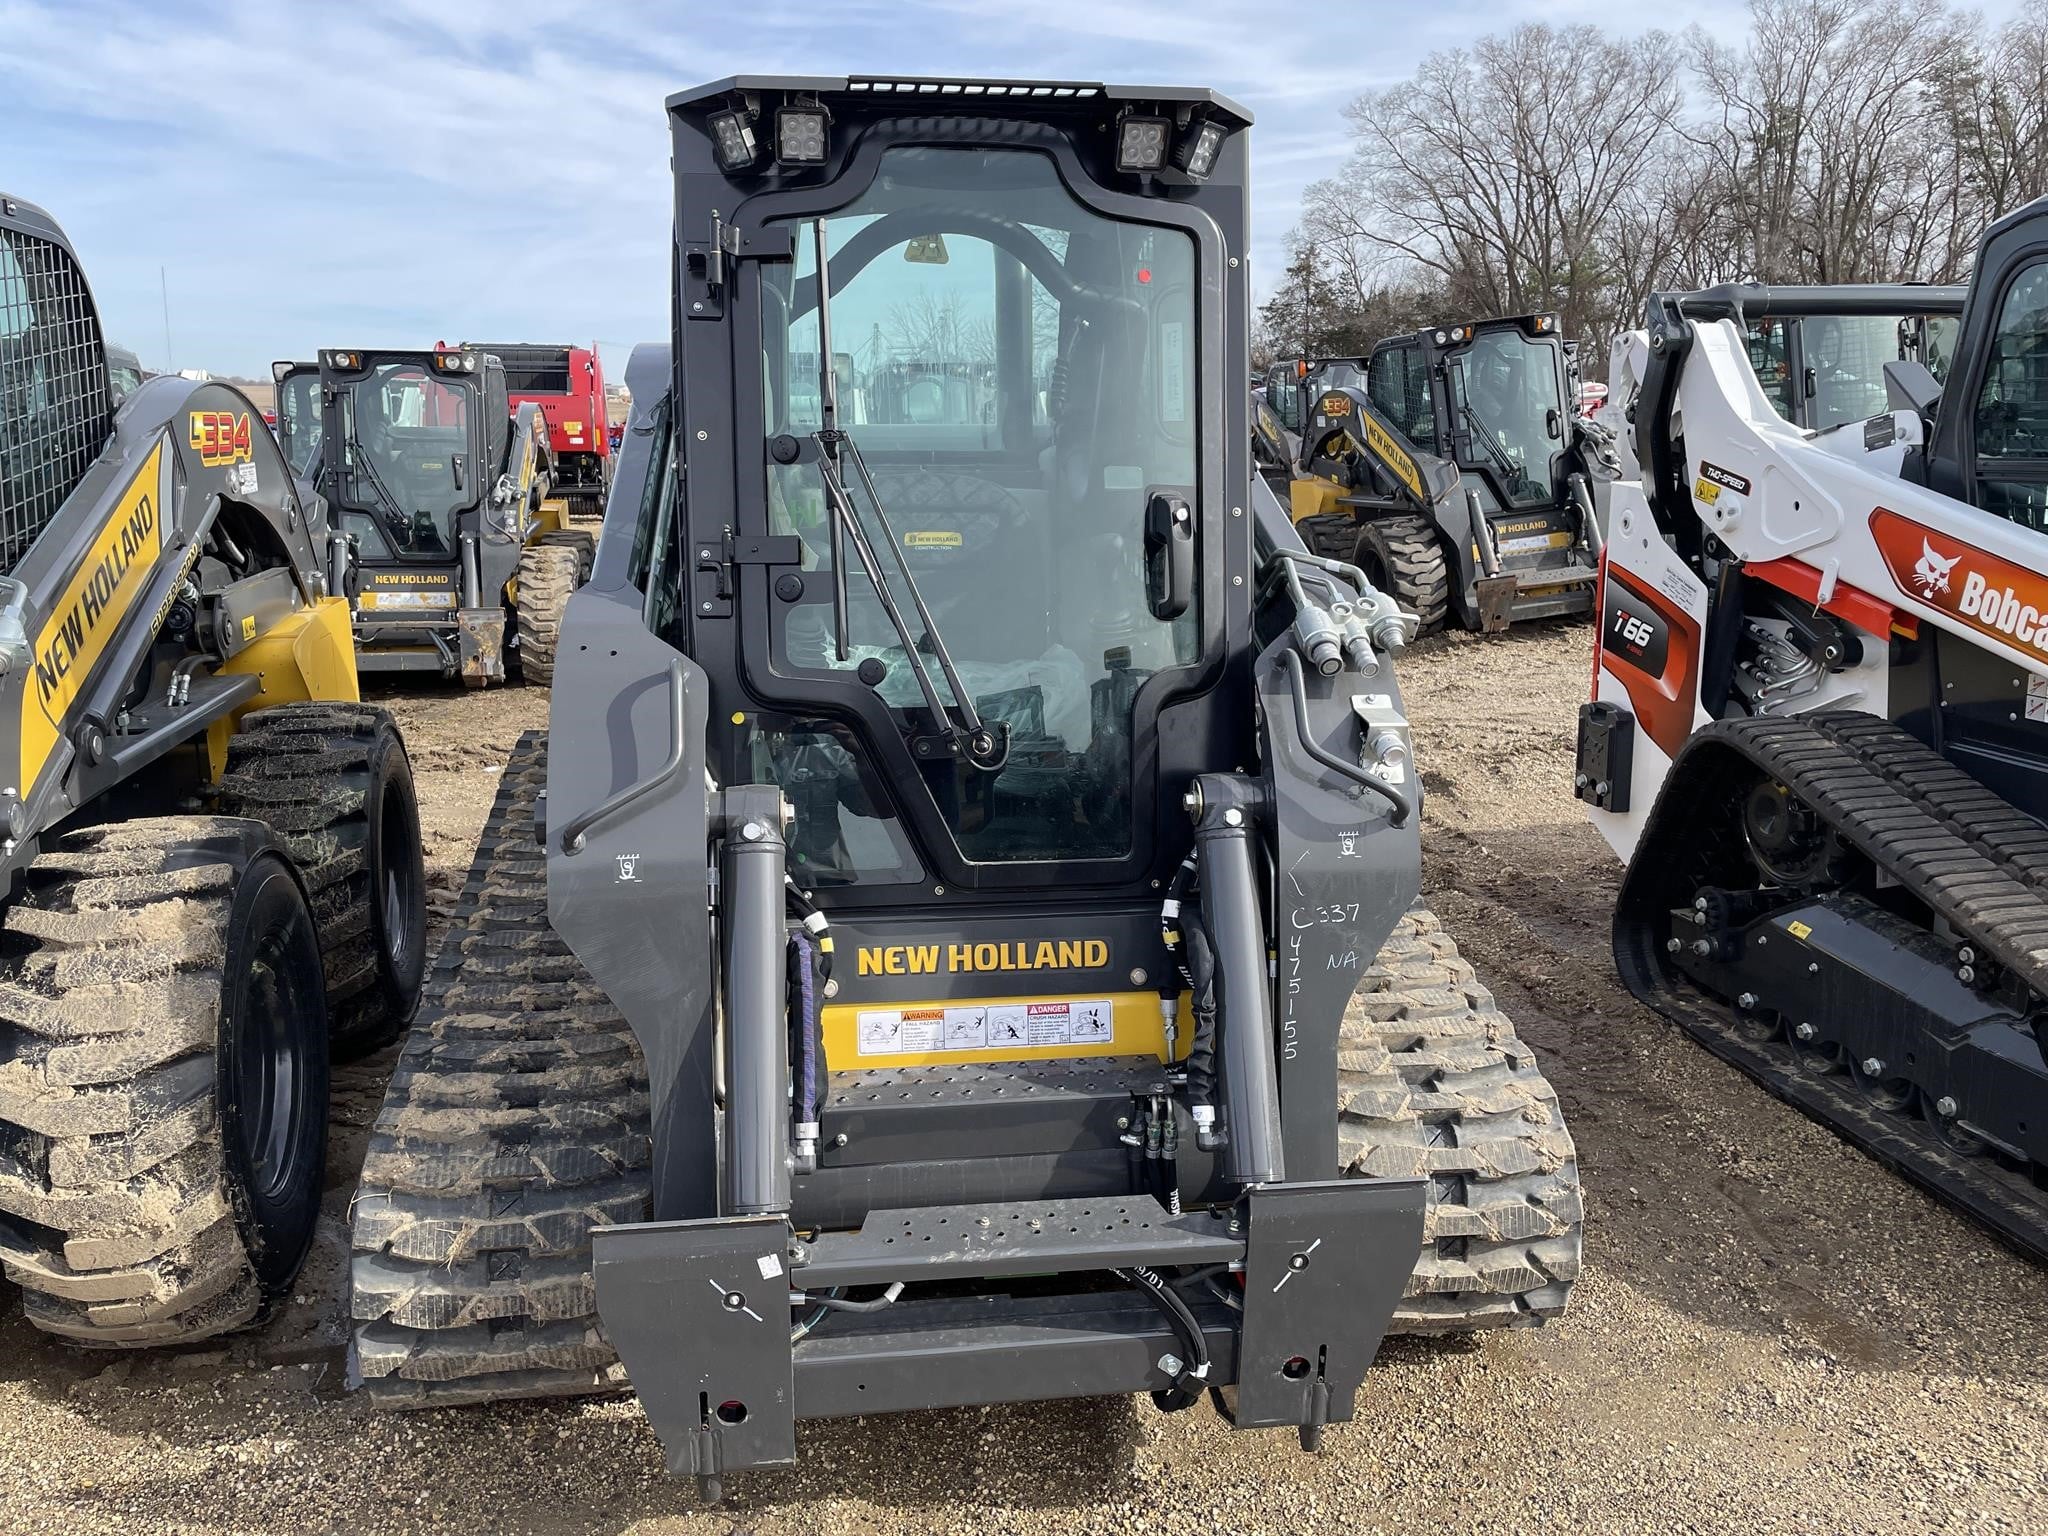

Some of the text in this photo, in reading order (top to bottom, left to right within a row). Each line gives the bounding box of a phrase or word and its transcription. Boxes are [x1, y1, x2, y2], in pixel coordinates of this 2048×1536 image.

[1323, 398, 1350, 416] L334
[190, 412, 252, 465] L334
[1368, 424, 1413, 477] NEW HOLLAND
[1707, 467, 1746, 490] TWO-SPEED
[1508, 520, 1548, 533] HOLLAND
[375, 575, 449, 584] NEW HOLLAND
[37, 493, 154, 702] NEW HOLLAND
[1614, 609, 1654, 647] T66
[858, 940, 1109, 976] NEW HOLLAND
[1326, 950, 1360, 971] NA
[909, 1011, 943, 1020] WARNING
[1038, 1004, 1067, 1014] DANGER
